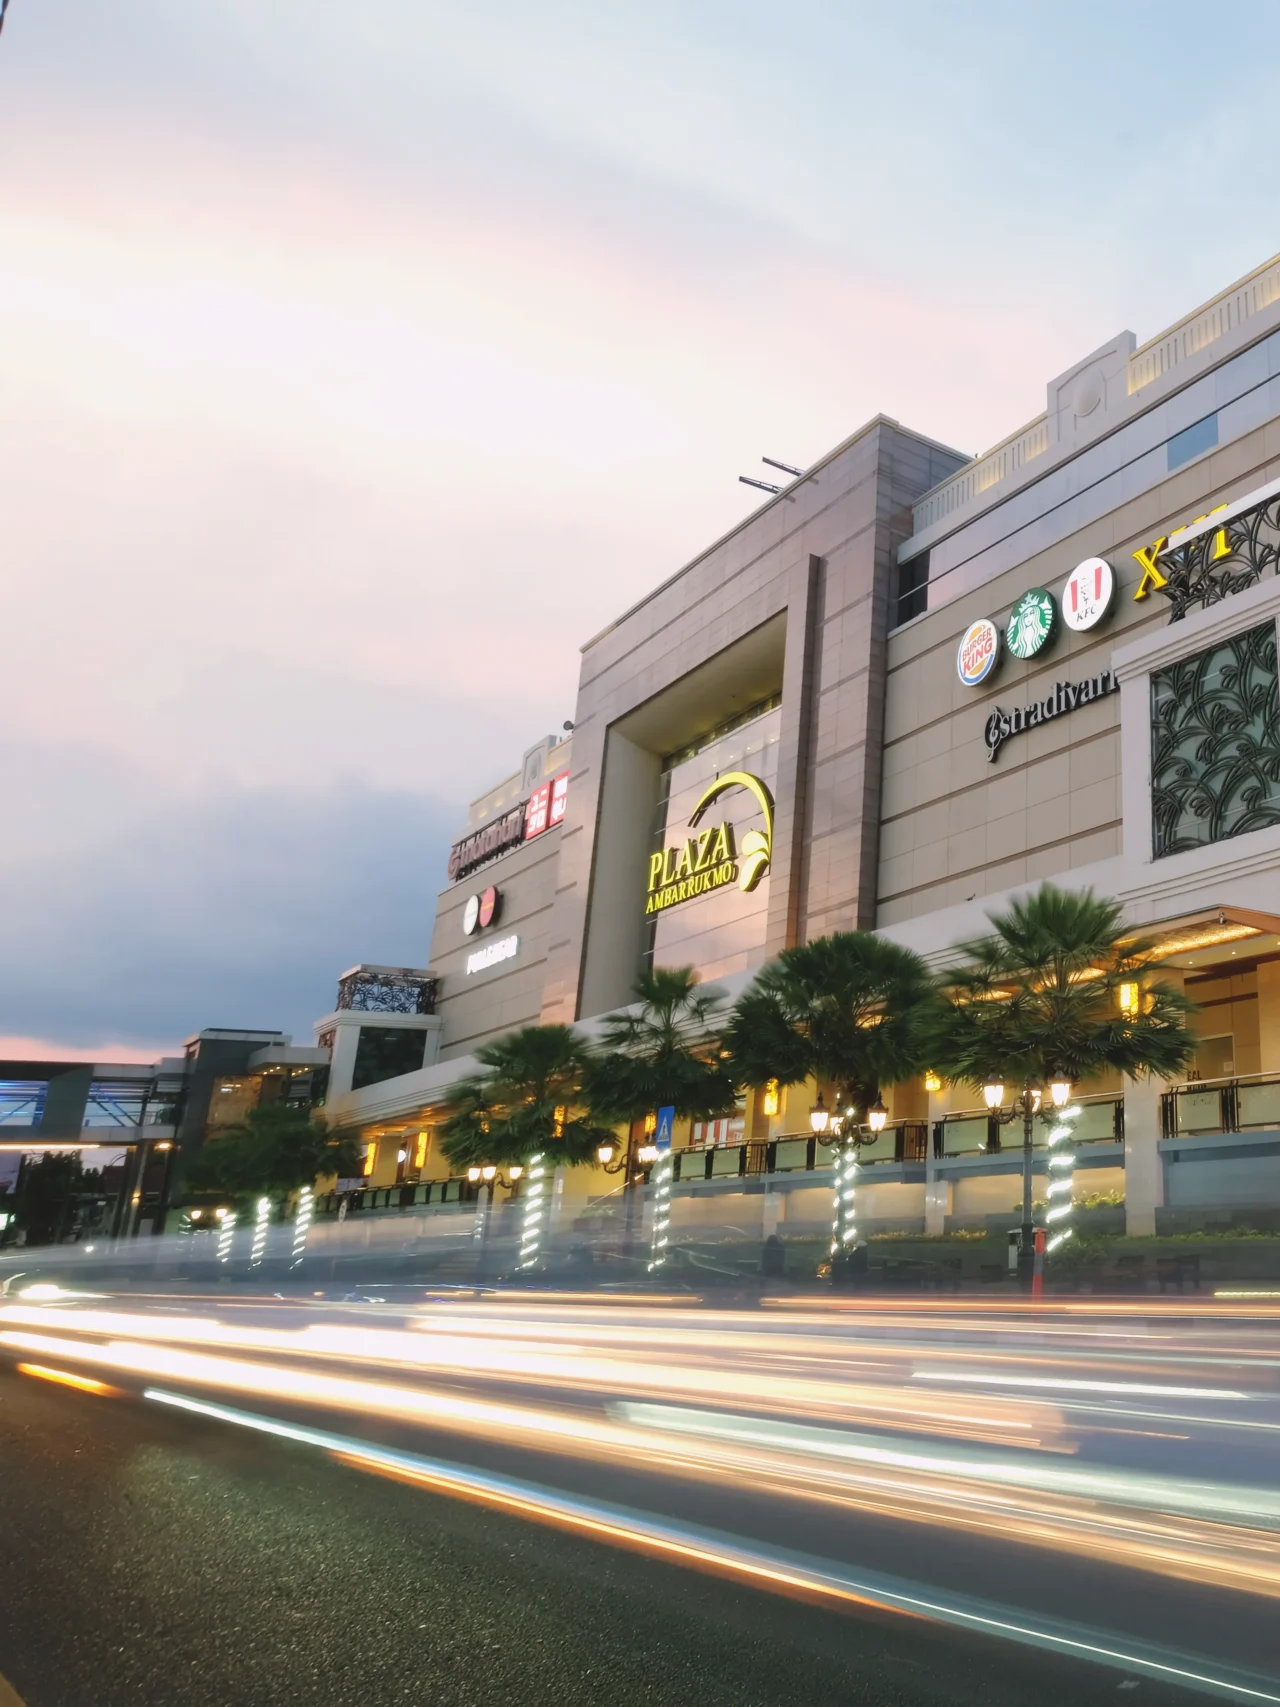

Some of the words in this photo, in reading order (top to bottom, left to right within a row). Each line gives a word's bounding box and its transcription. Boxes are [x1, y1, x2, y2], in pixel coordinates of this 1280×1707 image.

[1076, 604, 1096, 622] KFC
[962, 627, 993, 661] BURGER
[963, 637, 994, 676] KING
[647, 820, 731, 892] PLAZA
[645, 861, 733, 914] AMBARRUKMO
